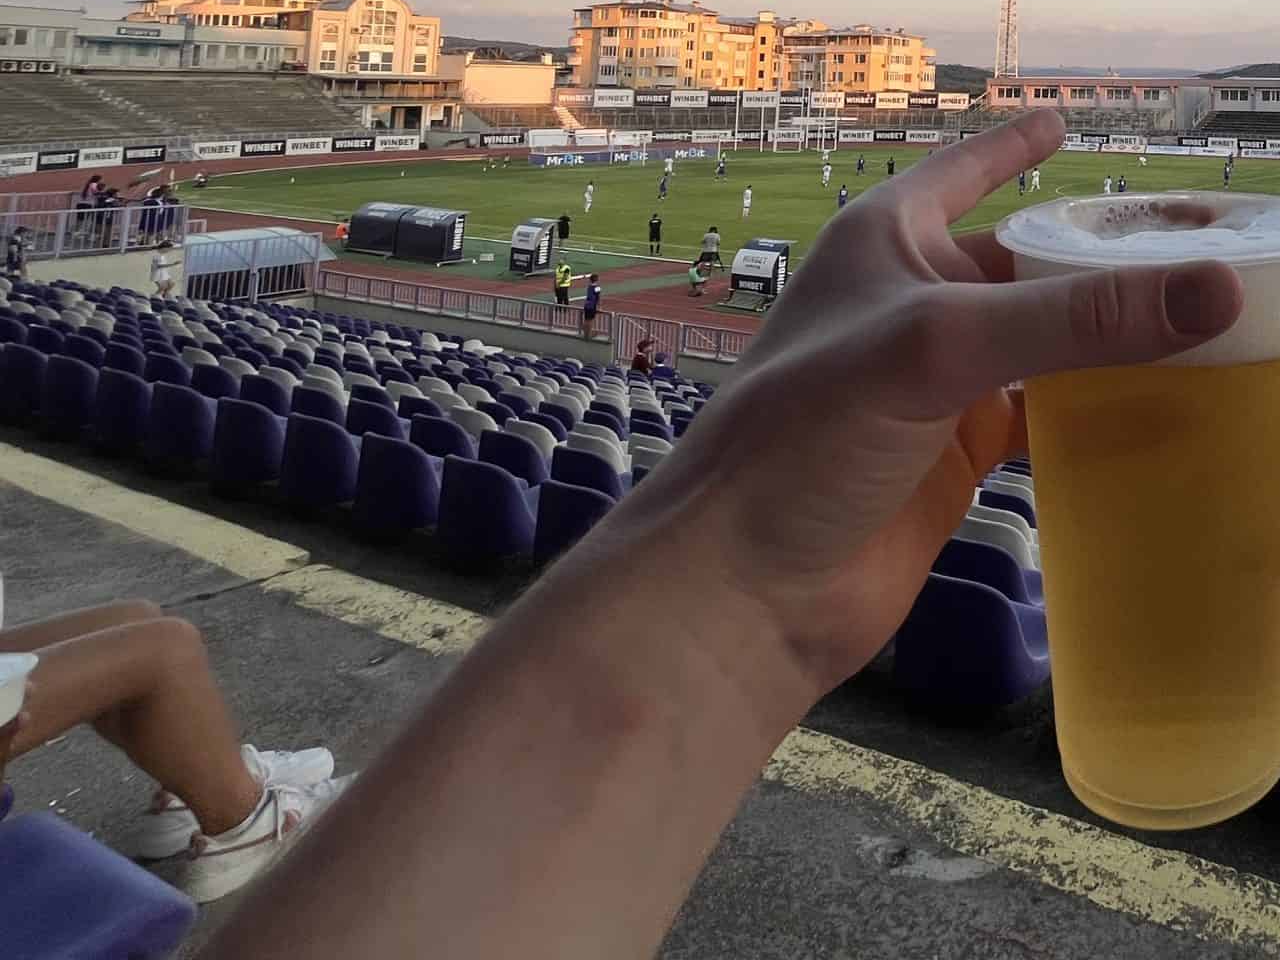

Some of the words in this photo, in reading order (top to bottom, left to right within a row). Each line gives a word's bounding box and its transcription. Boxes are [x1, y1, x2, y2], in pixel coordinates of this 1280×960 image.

[597, 94, 630, 103] WINBET
[636, 94, 669, 104] WINBET
[673, 95, 705, 103] WINBET
[910, 97, 936, 105] WINBET
[380, 138, 415, 146] WINBET
[483, 135, 521, 144] WINBET
[199, 145, 237, 154] WINBET
[244, 142, 282, 152] WINBET
[290, 141, 328, 150] WINBET
[546, 153, 584, 165] MrBit
